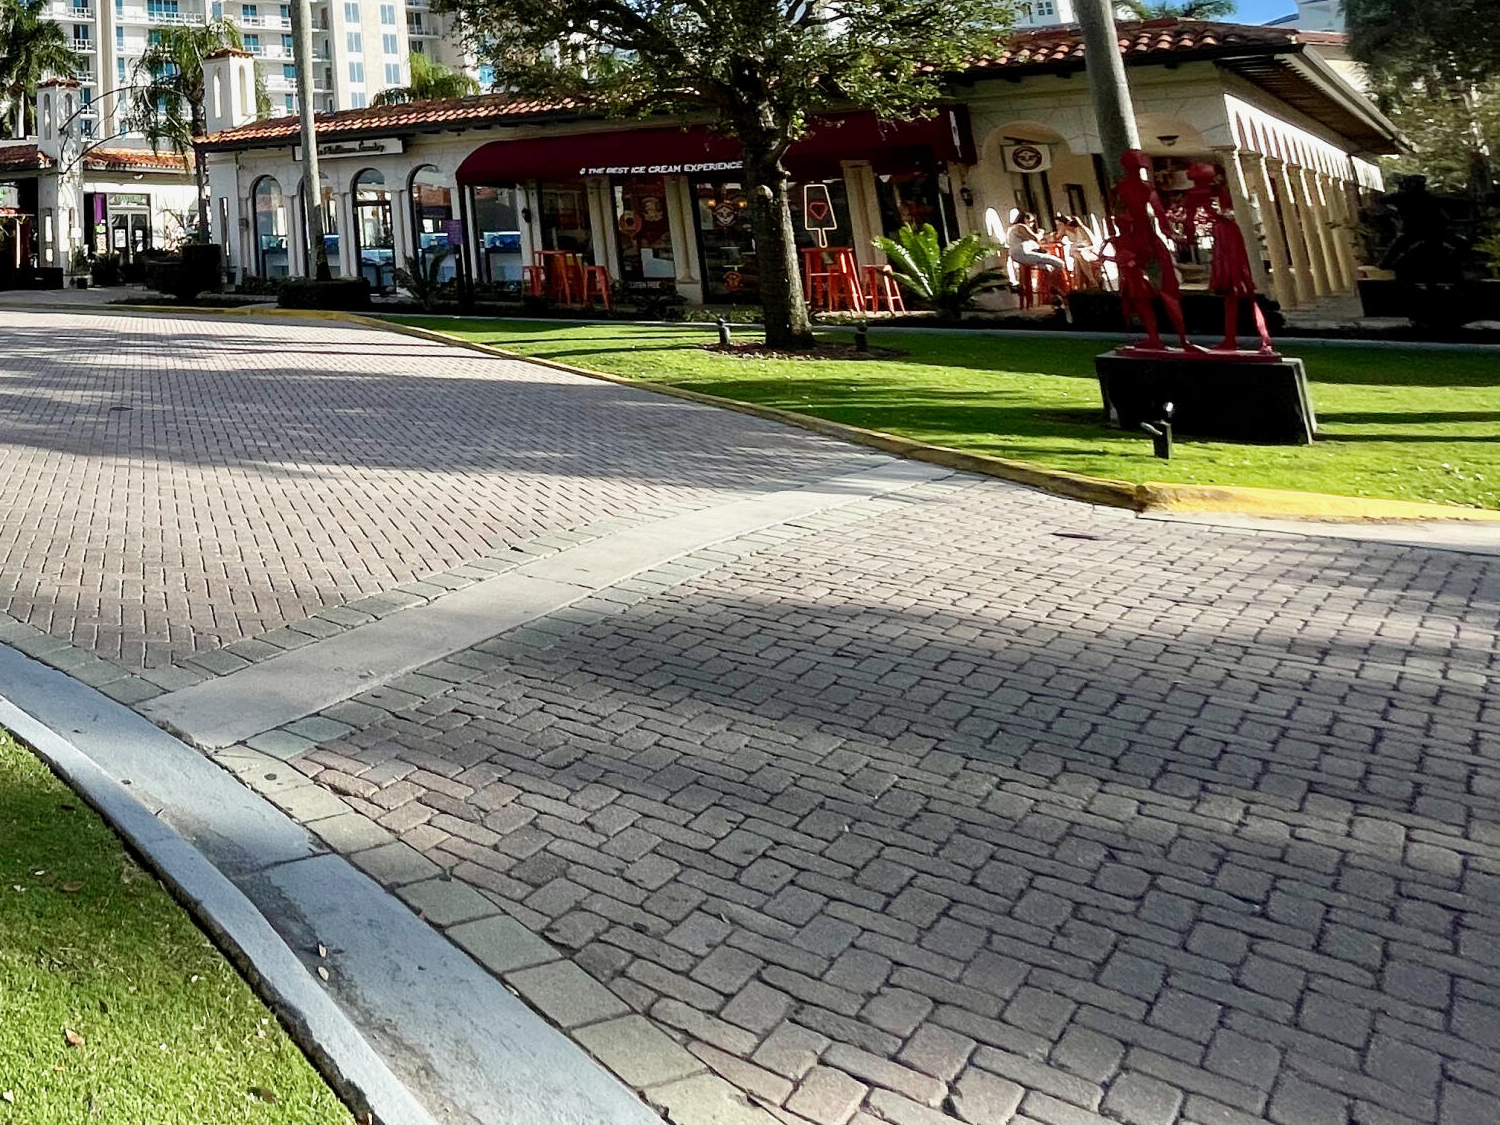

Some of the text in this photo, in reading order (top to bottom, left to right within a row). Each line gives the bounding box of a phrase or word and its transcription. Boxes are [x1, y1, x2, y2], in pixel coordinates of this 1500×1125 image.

[606, 166, 630, 174] BEST
[630, 165, 647, 174] ICE
[648, 164, 681, 174] CREAM
[683, 160, 744, 172] EXPERIENCE
